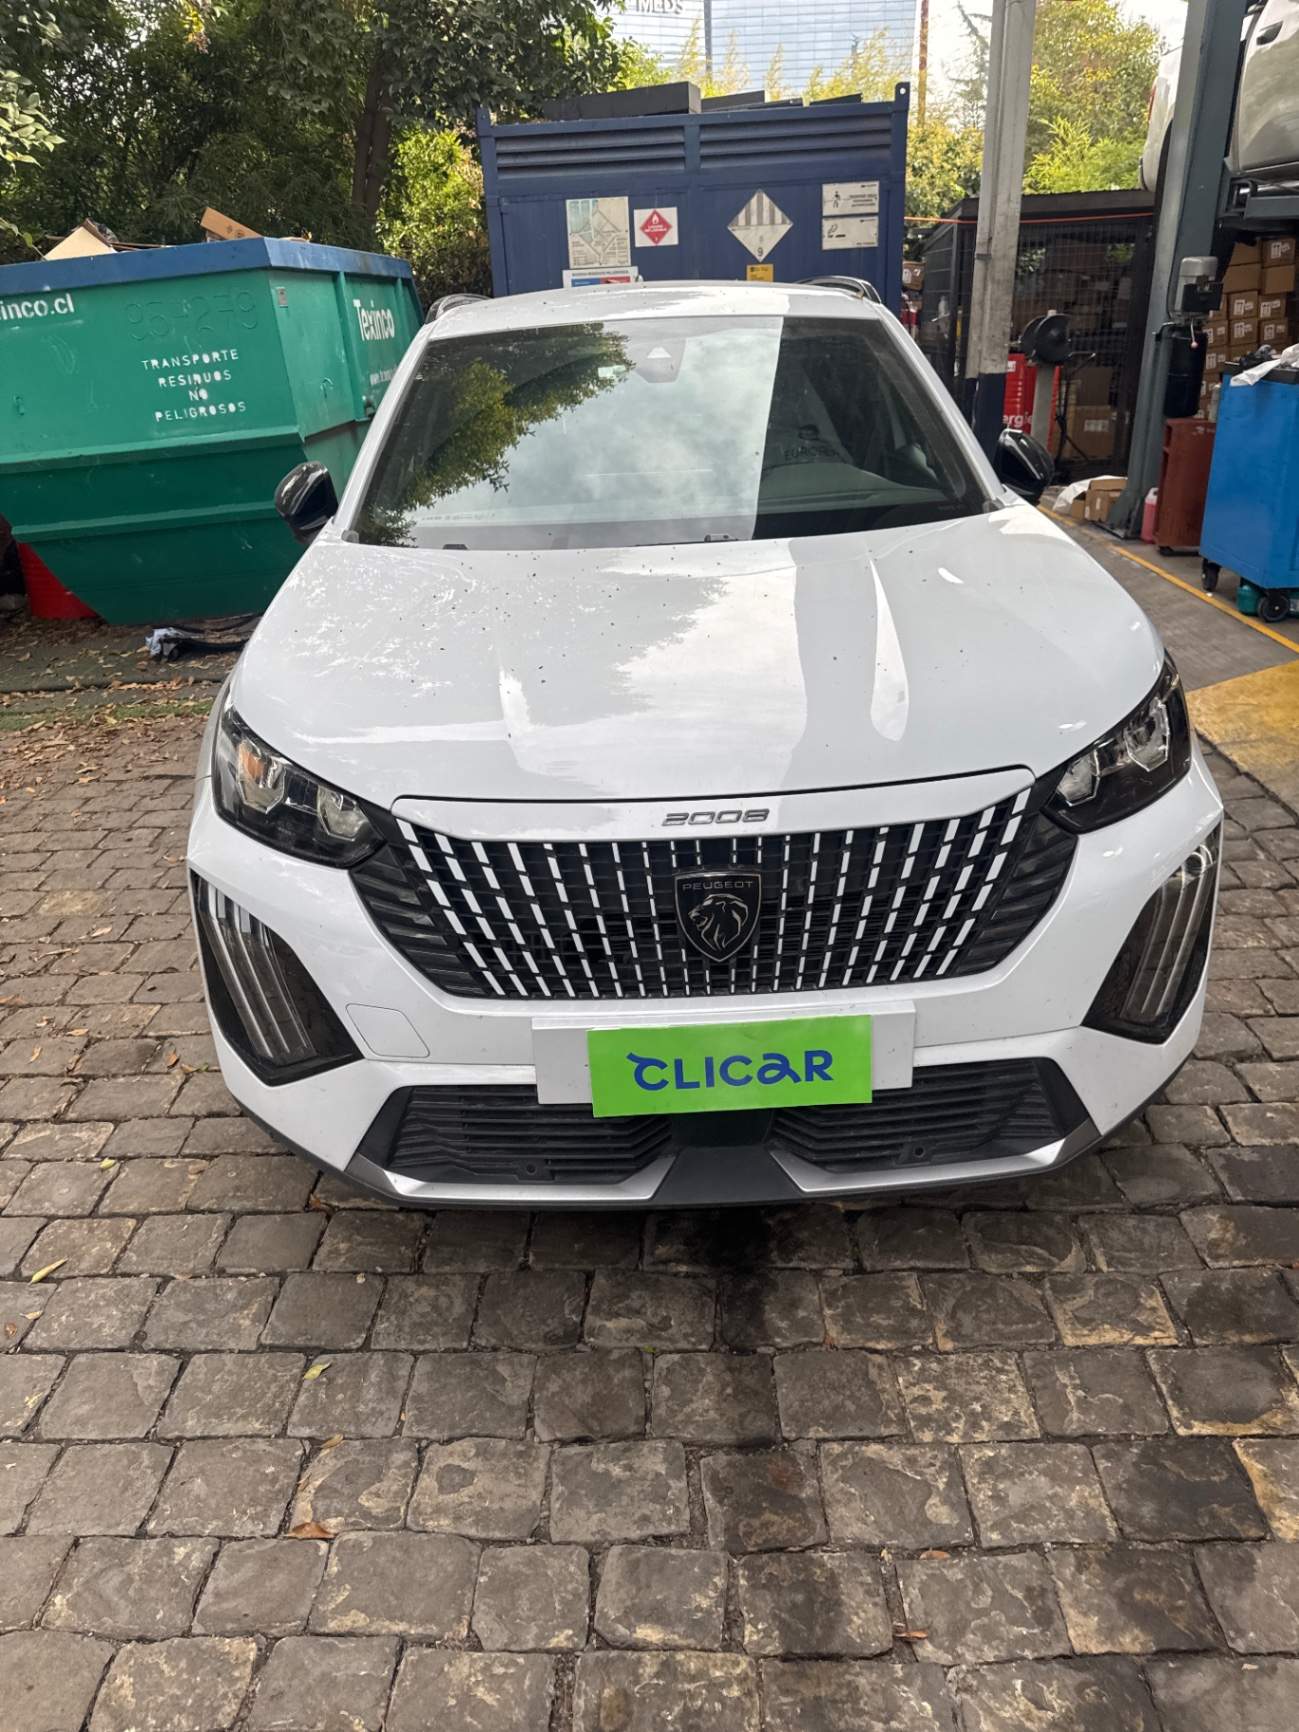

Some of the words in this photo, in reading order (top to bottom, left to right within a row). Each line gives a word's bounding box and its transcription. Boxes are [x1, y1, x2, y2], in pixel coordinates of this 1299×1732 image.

[0, 293, 75, 320] inco.cl
[352, 299, 395, 341] Texinco
[141, 349, 239, 371] TRANSPORTE
[158, 370, 232, 388] RESIDUOS
[188, 388, 208, 401] NO
[154, 401, 246, 422] PELIGROSOS
[662, 808, 770, 826] 2008
[682, 880, 753, 891] PEUGEOT
